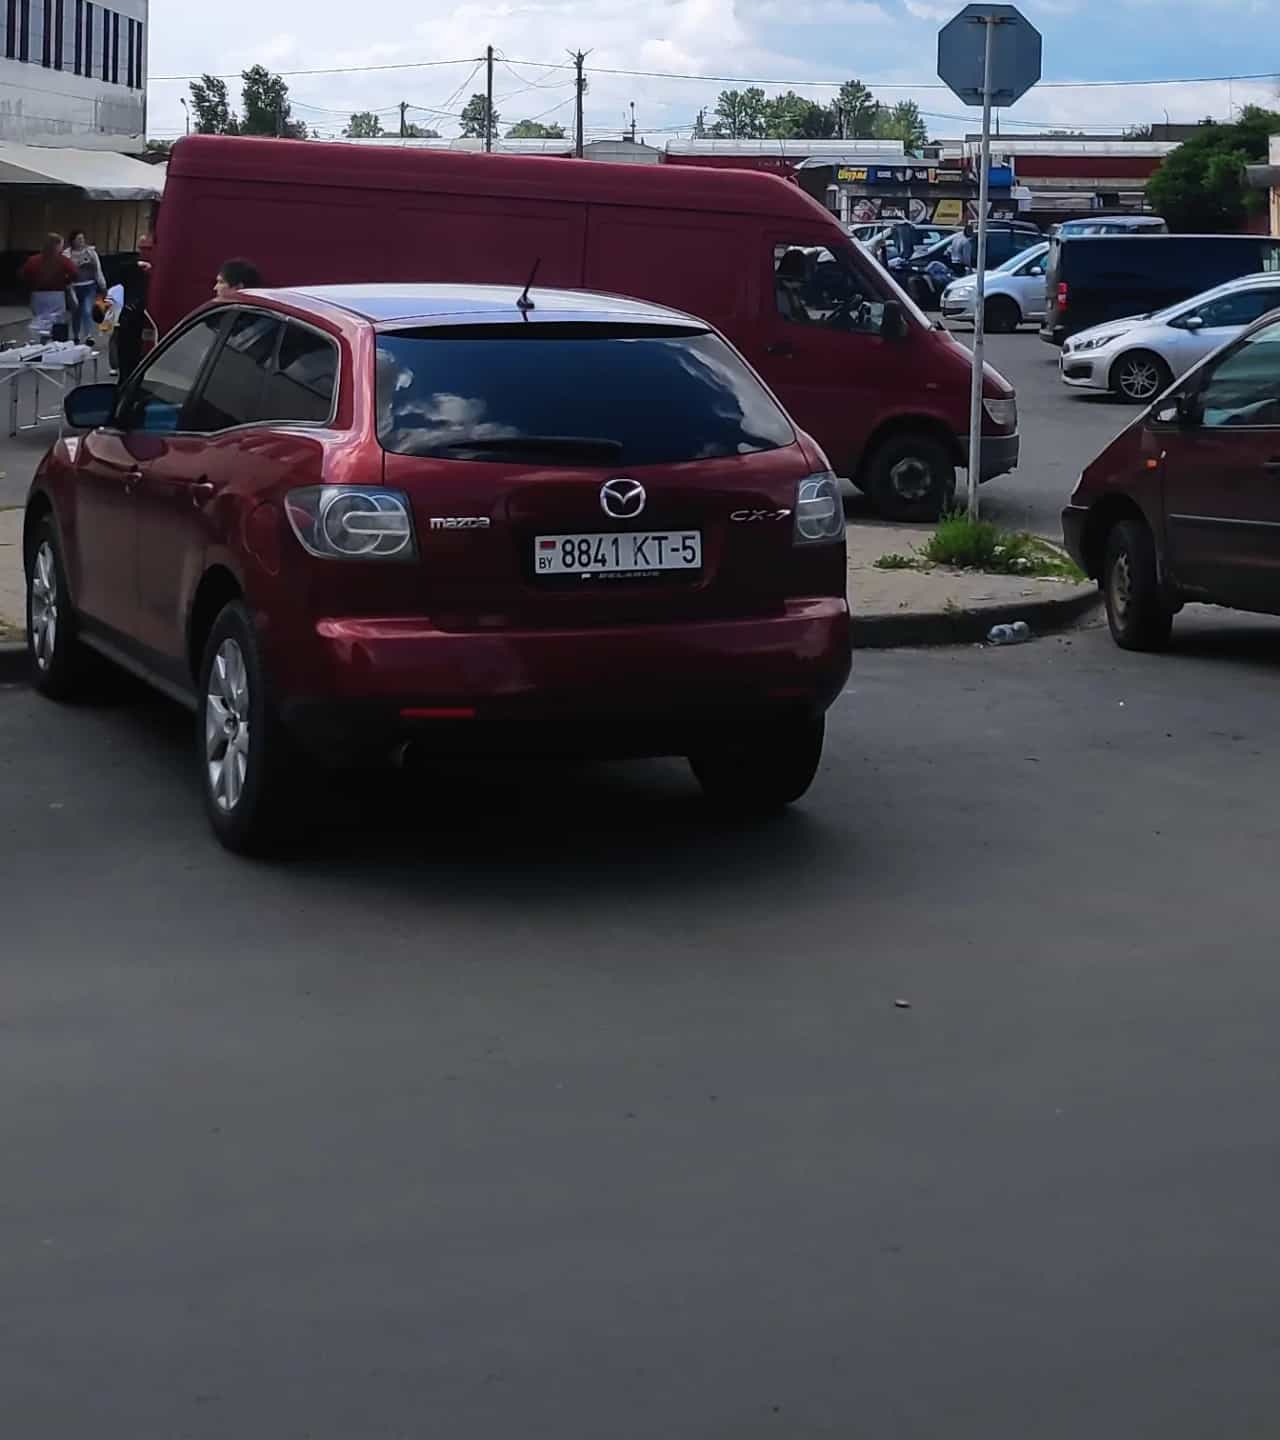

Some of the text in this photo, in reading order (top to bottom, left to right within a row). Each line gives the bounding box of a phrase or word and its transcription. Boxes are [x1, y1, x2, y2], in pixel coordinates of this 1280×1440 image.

[730, 508, 791, 521] CX-7
[539, 535, 697, 569] BY 8841 KT-5
